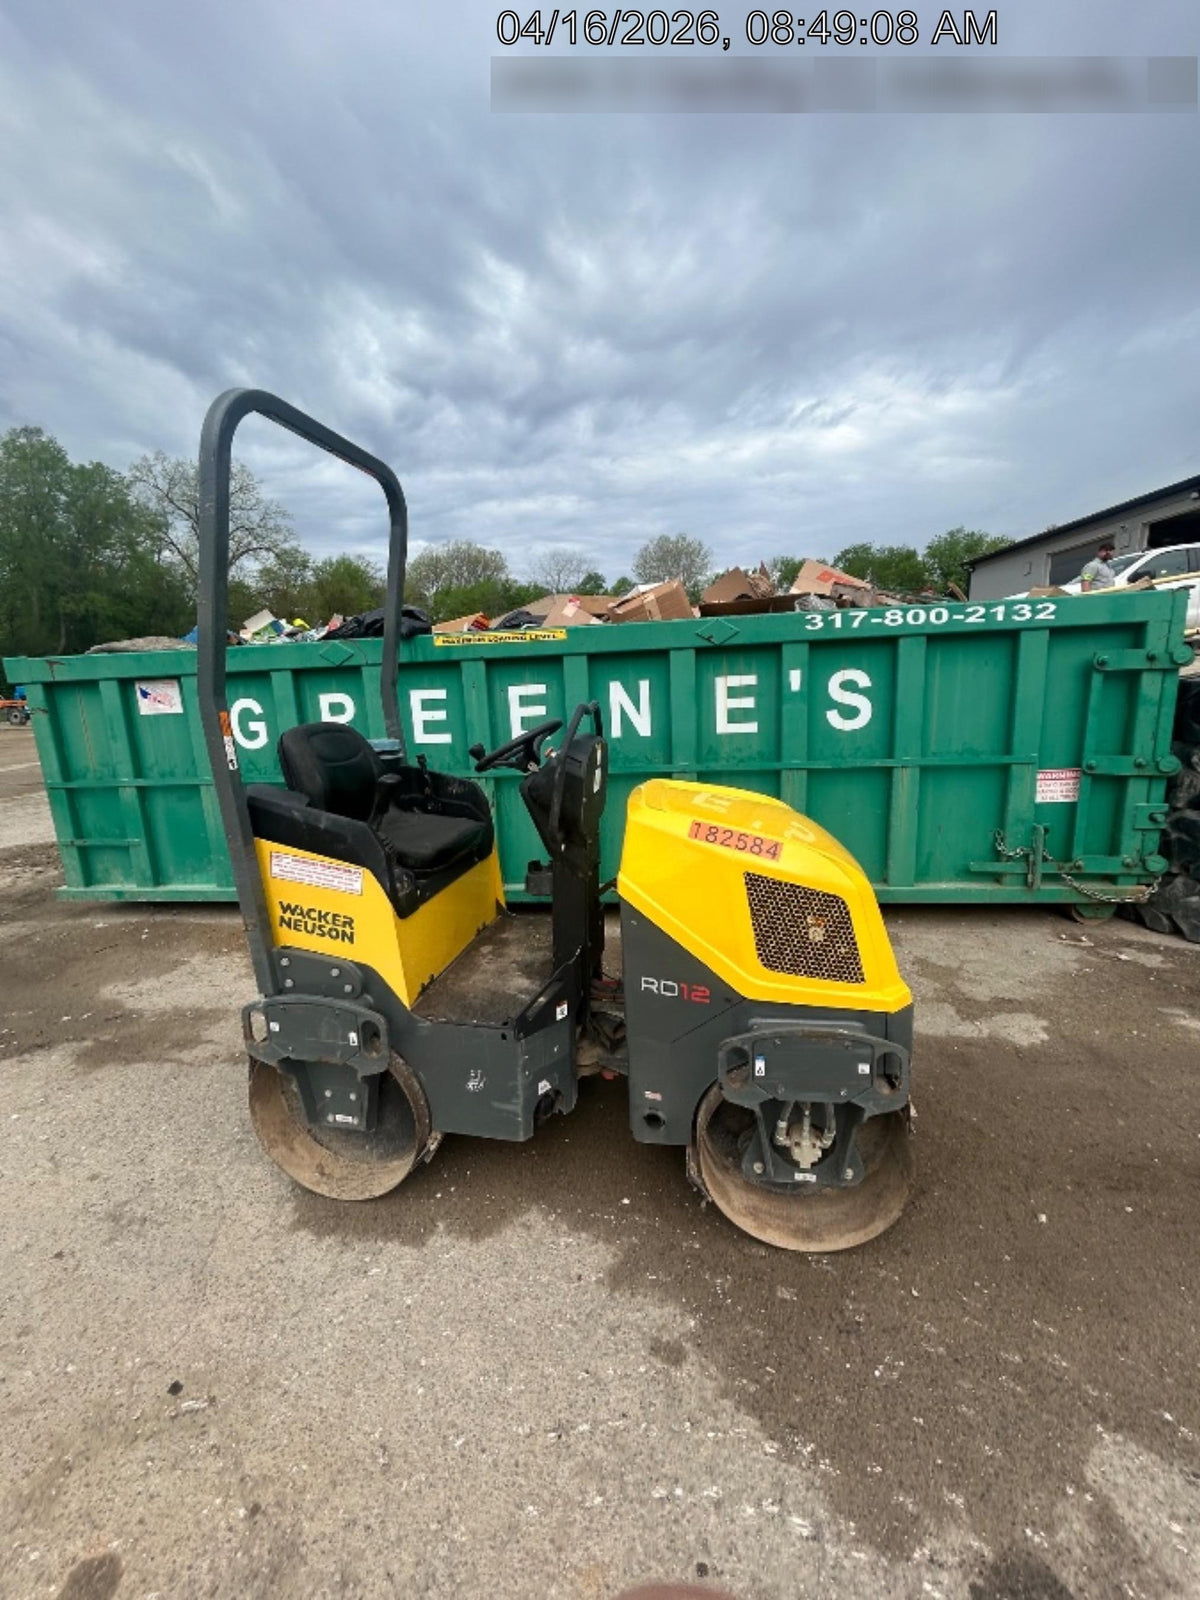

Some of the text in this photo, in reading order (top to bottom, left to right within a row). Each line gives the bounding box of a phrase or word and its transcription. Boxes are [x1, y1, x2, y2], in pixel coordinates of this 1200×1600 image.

[804, 602, 1057, 631] 317-800-2132
[693, 821, 780, 860] 182584
[278, 900, 355, 931] WACKER
[278, 915, 355, 945] NEUSON
[641, 977, 710, 1003] RD12
